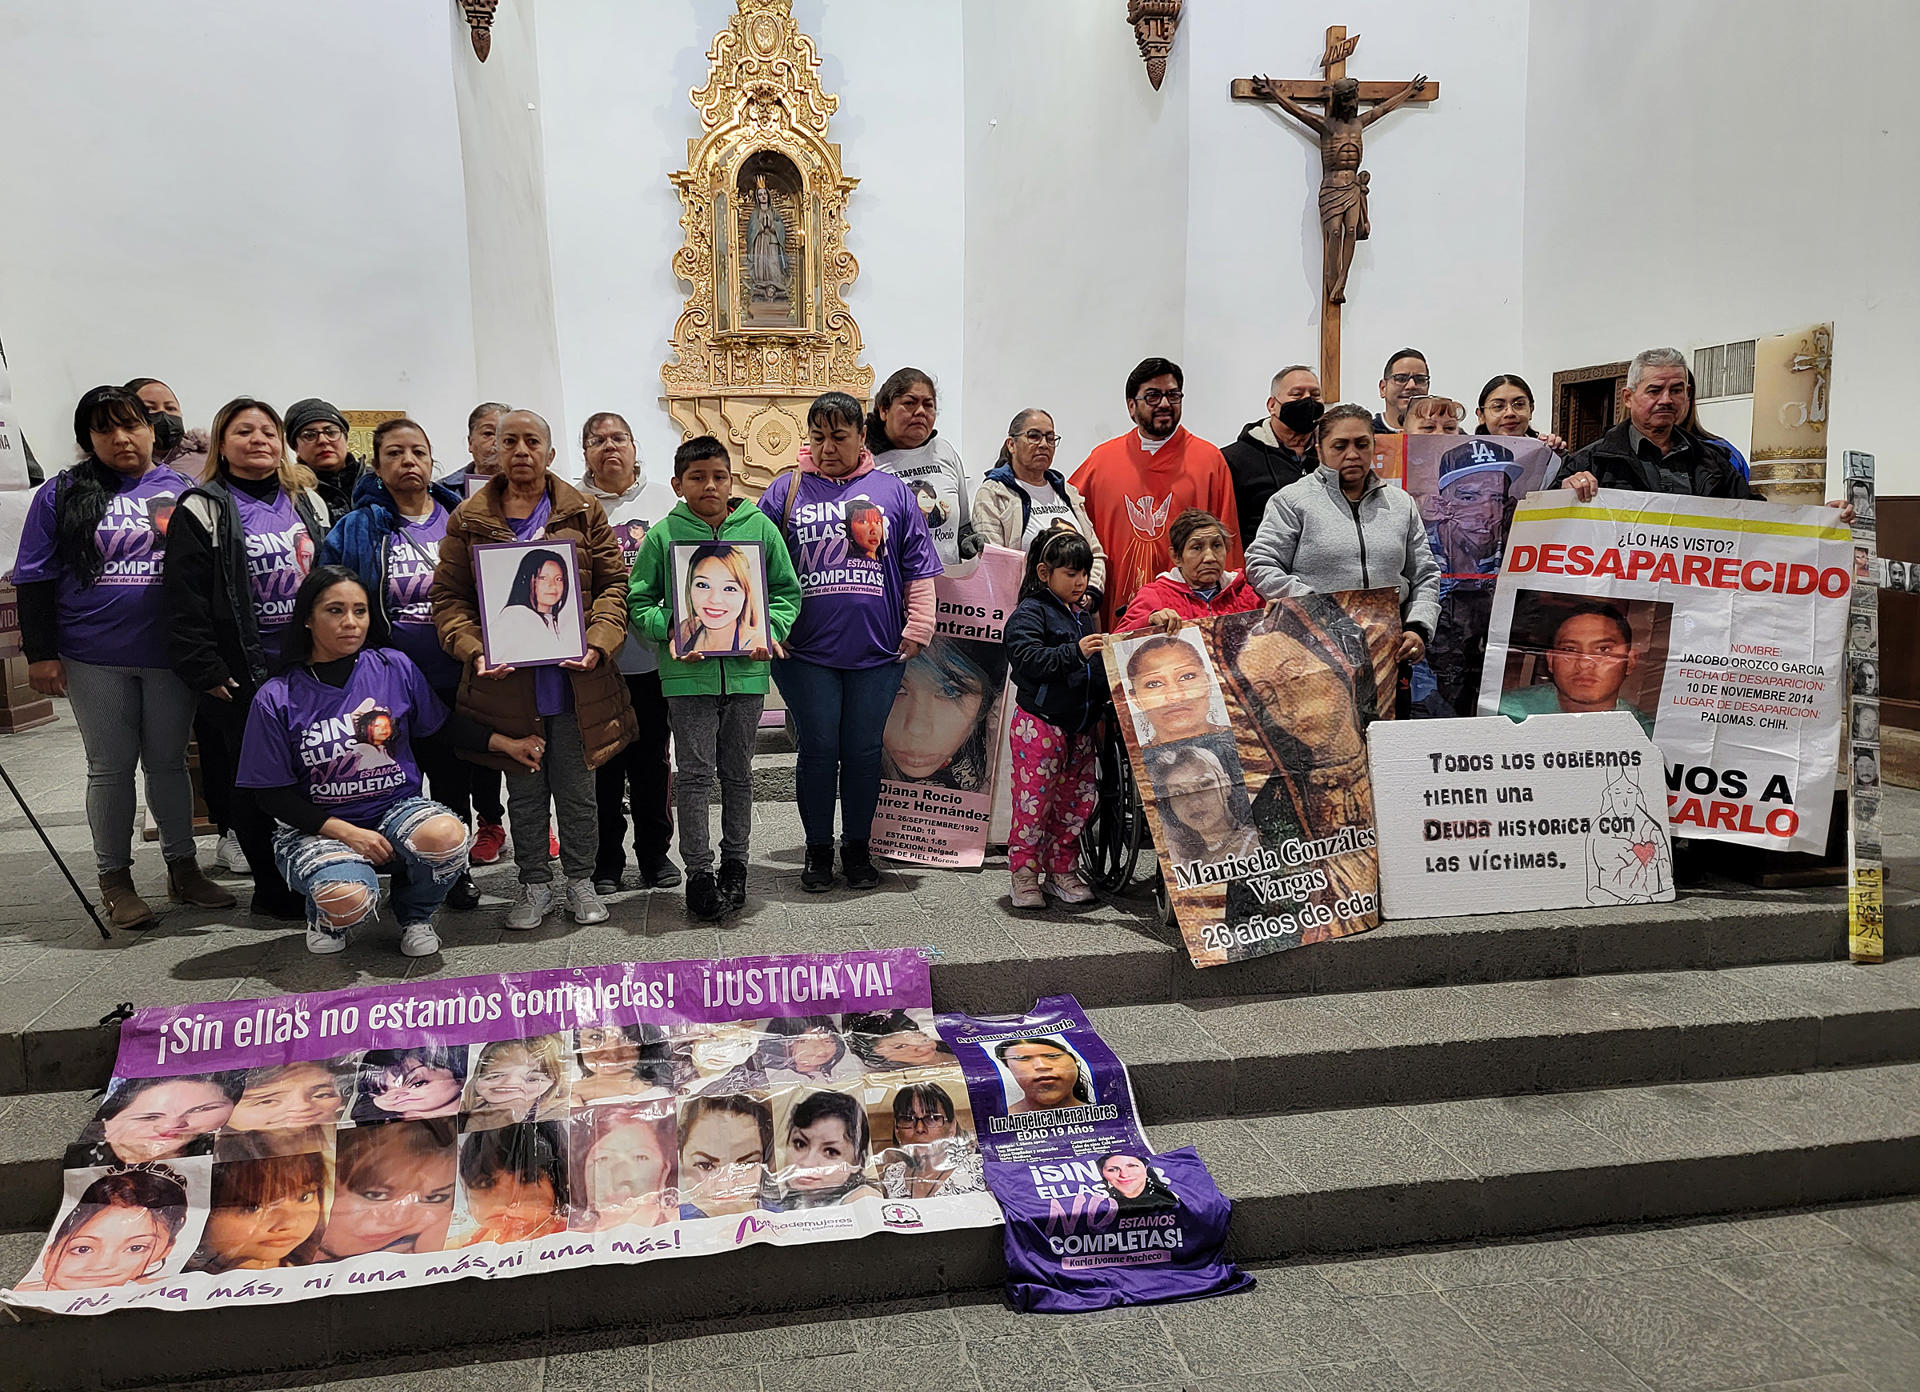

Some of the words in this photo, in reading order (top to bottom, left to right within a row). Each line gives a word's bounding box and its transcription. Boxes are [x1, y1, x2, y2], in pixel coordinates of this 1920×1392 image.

[1469, 440, 1496, 463] LA
[97, 515, 151, 531] LLAS
[797, 523, 847, 545] ELLAS
[1617, 531, 1647, 548] ¿LO
[1650, 535, 1679, 550] HAS
[1683, 537, 1734, 554] VISTO?
[799, 535, 849, 573] NO
[847, 559, 882, 571] ESTAMOS
[388, 562, 433, 578] LLA
[799, 569, 884, 588] COMPLETAS!
[1507, 544, 1850, 599] DESAPARECIDO
[253, 599, 296, 615] COM
[390, 602, 433, 615] COM
[992, 607, 1004, 621] a
[1730, 643, 1783, 657] NOMBRE:
[1680, 653, 1729, 667] JACOBO
[1731, 657, 1779, 672] OROZCO
[1781, 664, 1825, 676] GARCIA
[1679, 668, 1719, 682] FECHA
[1720, 672, 1736, 683] DE
[1738, 674, 1826, 692] DESAPARICION:
[1686, 682, 1699, 693] 10
[1701, 683, 1718, 695] DE
[1720, 686, 1786, 702] NOVIEMBRE
[1788, 692, 1814, 705] 2014
[1673, 695, 1715, 709] LUGAR
[1717, 699, 1732, 710] DE
[1733, 701, 1821, 719] DESAPARICION:
[1700, 712, 1756, 727] PALOMAS.
[1759, 717, 1789, 730] CHIH.
[301, 738, 358, 767] ELLAS
[360, 764, 401, 779] ESTAMOS
[309, 771, 407, 796] COMPLETAS!
[880, 783, 918, 799] Diana
[923, 789, 963, 805] Rocio
[1759, 774, 1794, 805] A
[914, 800, 990, 823] Hernández
[898, 815, 980, 833] 26/SEPTIEMBRE/1992
[902, 824, 925, 834] EDAD:
[927, 828, 937, 836] 18
[872, 838, 926, 853] COMPLEXION:
[886, 831, 929, 844] ESTATURA:
[931, 838, 948, 847] 1.65
[897, 850, 908, 858] DE
[910, 852, 930, 861] PIEL:
[1172, 847, 1279, 890] Marisela
[1282, 827, 1376, 867] Gonzáles
[1247, 868, 1328, 905] Vargas
[1201, 924, 1235, 952] 26
[1236, 911, 1299, 945] años
[1299, 900, 1333, 930] de
[157, 1014, 224, 1065] ¡Sin
[233, 1006, 311, 1048] ellas
[319, 1006, 359, 1038] no
[368, 991, 502, 1030] estamos
[511, 973, 676, 1019] completas!
[703, 966, 841, 1008] ¡JUSTICIA
[845, 961, 893, 998] YA!
[989, 1116, 1009, 1133] Luz
[1008, 1110, 1054, 1131] Angélica
[1055, 1107, 1084, 1126] Mena
[1085, 1104, 1118, 1121] Flores
[1016, 1131, 1049, 1141] EDAD
[1052, 1128, 1065, 1137] 19
[1067, 1125, 1095, 1135] Años
[1028, 1160, 1103, 1186] ¡SIN
[1036, 1182, 1110, 1199] ELLAS
[1046, 1194, 1119, 1236] NO
[1118, 1214, 1176, 1229] ESTAMOS
[1050, 1228, 1184, 1255] COMPLETAS!
[348, 1267, 407, 1286] una
[539, 1243, 595, 1262] una
[612, 1229, 681, 1255] más!
[1069, 1257, 1093, 1266] Karla
[1126, 1253, 1162, 1262] Pacheco
